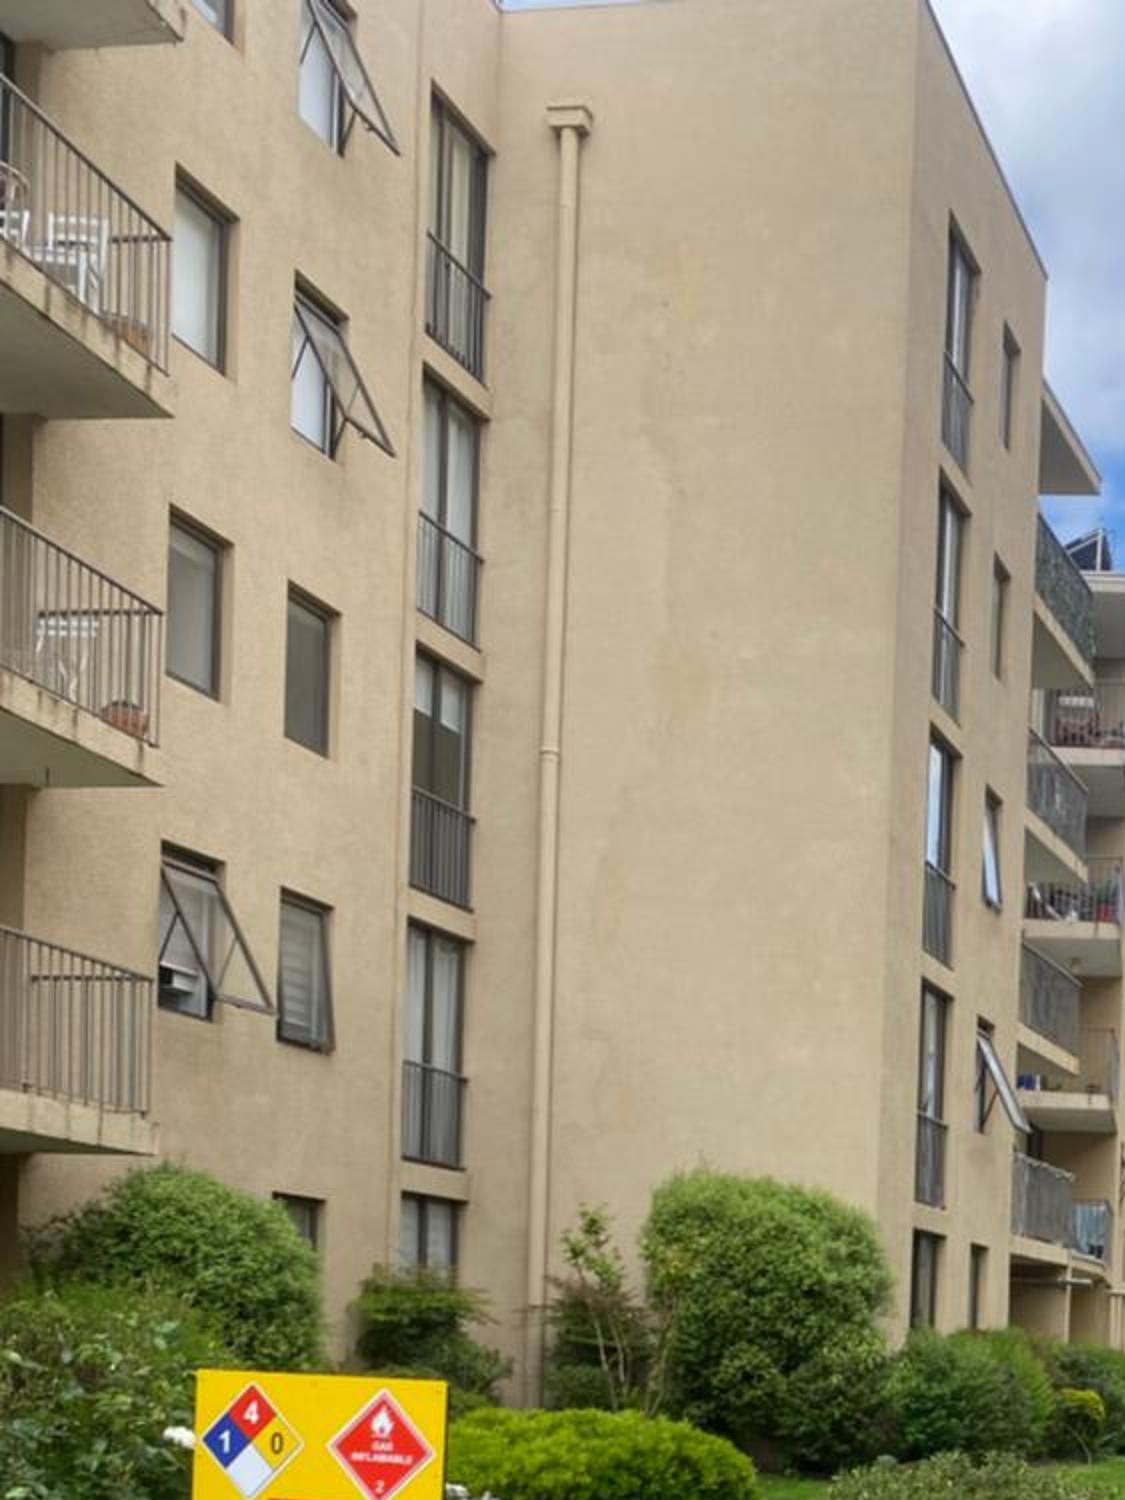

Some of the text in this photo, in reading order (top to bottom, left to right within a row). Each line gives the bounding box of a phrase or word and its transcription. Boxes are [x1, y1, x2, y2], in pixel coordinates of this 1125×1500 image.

[243, 1400, 259, 1424] 4
[219, 1429, 284, 1454] 1 0
[374, 1480, 385, 1494] 2
